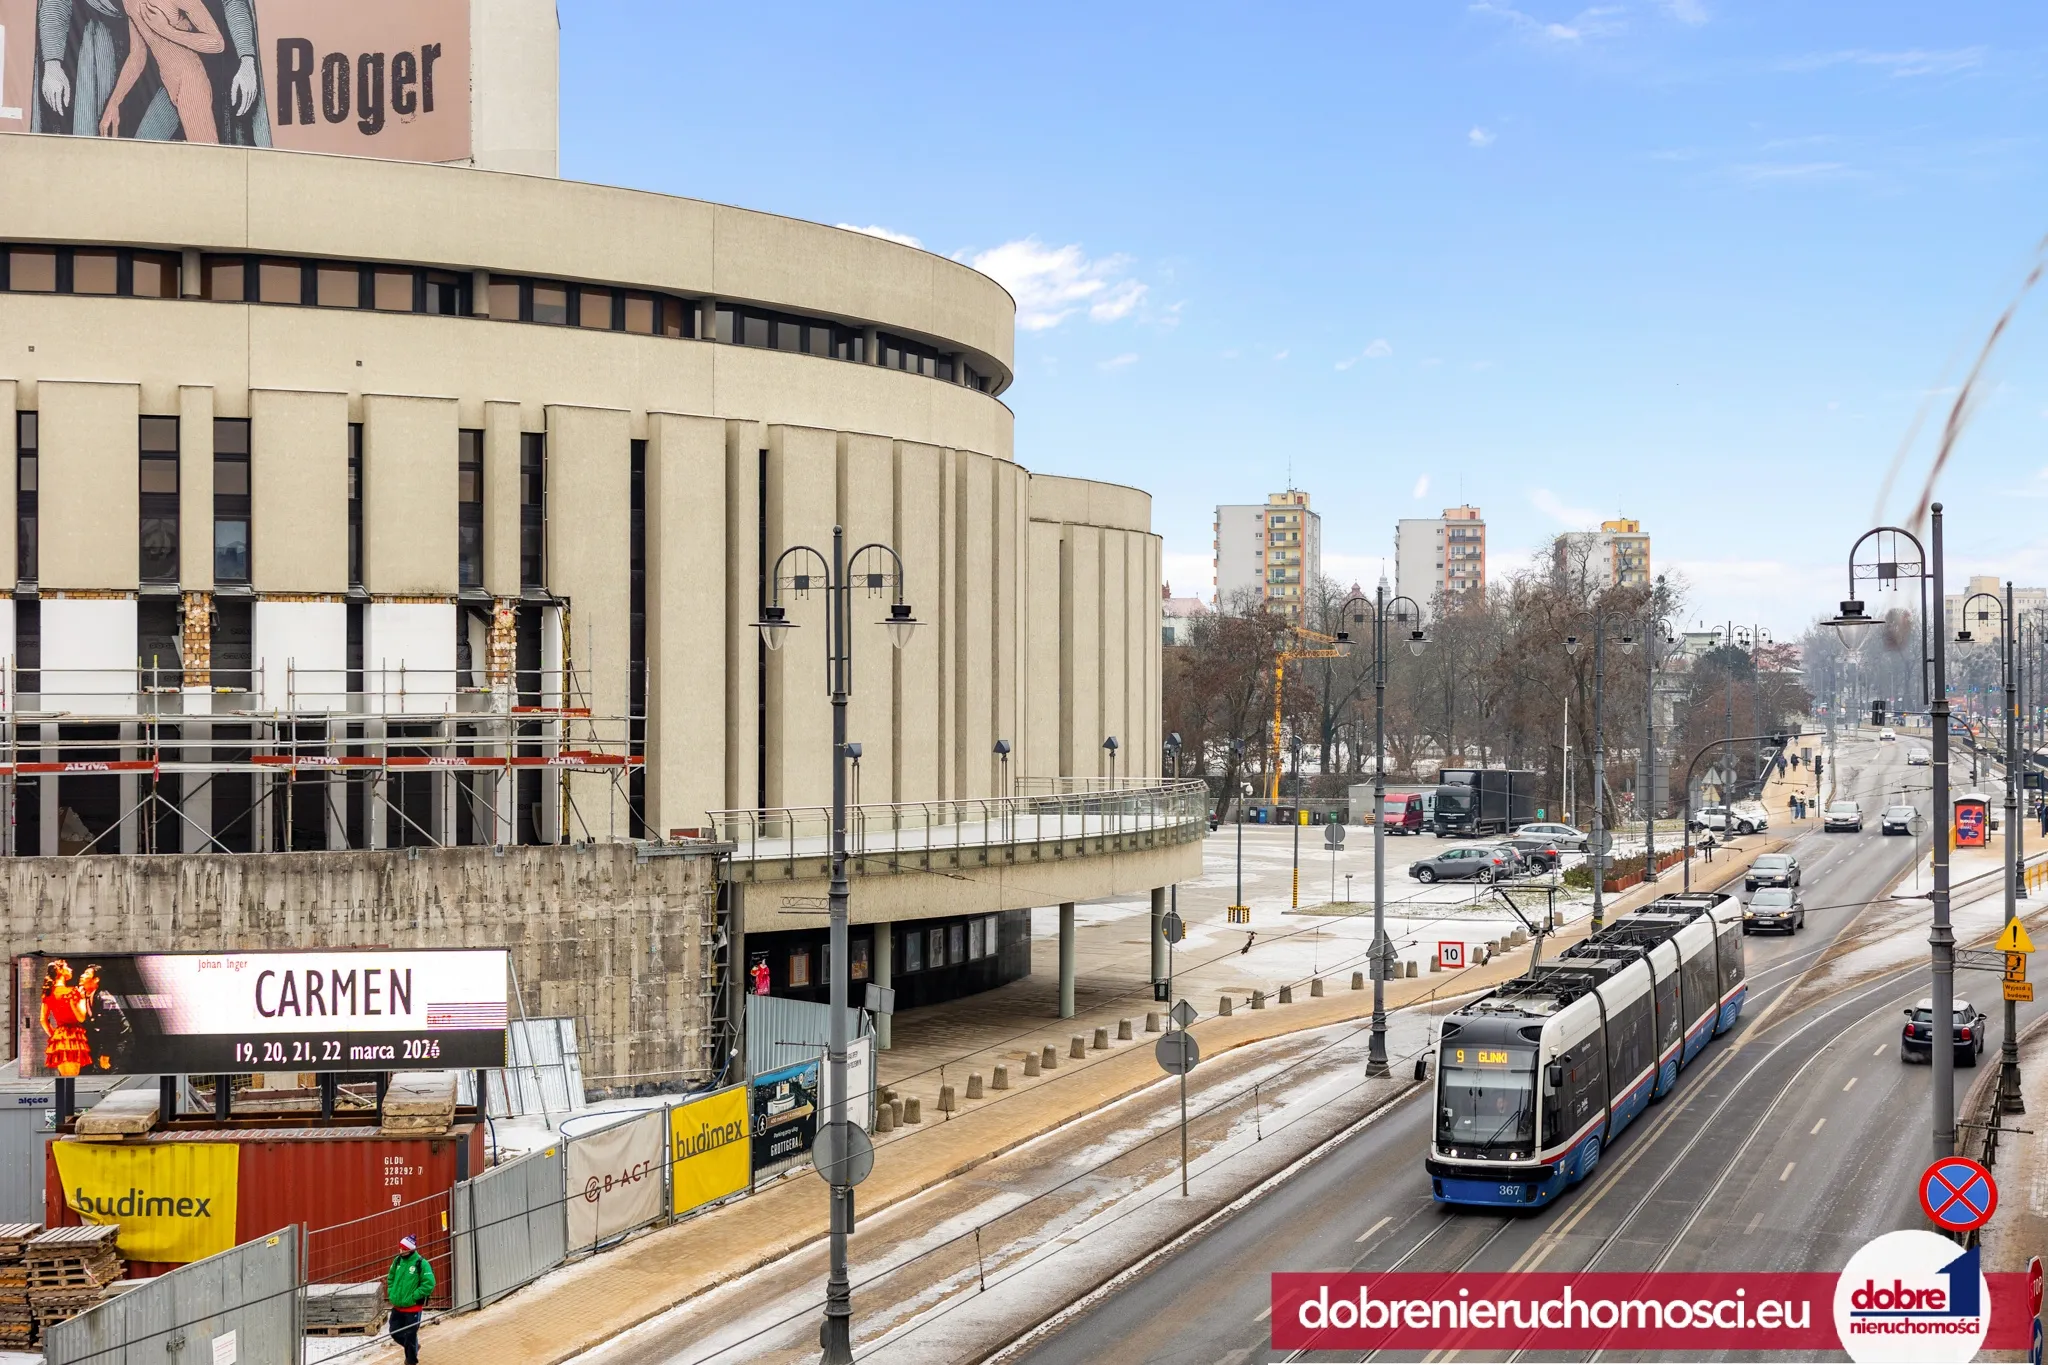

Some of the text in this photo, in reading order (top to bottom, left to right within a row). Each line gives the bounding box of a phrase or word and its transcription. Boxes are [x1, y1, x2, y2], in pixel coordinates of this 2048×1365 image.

[277, 37, 441, 135] Roger
[64, 762, 109, 771] ALTIVA
[298, 756, 340, 765] ALTIVA
[429, 757, 469, 765] ALTIVA
[548, 756, 585, 765] ALTIVA
[1444, 948, 1458, 960] 10
[198, 958, 247, 972] Johan Inger
[255, 968, 412, 1018] CARMEN
[235, 1039, 440, 1064] 19, 20, 21, 22 marca 2026
[1456, 1049, 1508, 1063] 9 GLINKI
[676, 1119, 743, 1160] budimex
[384, 1156, 404, 1165] GLDU
[384, 1166, 413, 1176] 328292
[604, 1160, 650, 1193] B-ACT
[384, 1177, 403, 1186] 22G1
[1499, 1185, 1520, 1196] 367
[76, 1187, 211, 1218] budimex
[2030, 1276, 2043, 1299] STOP
